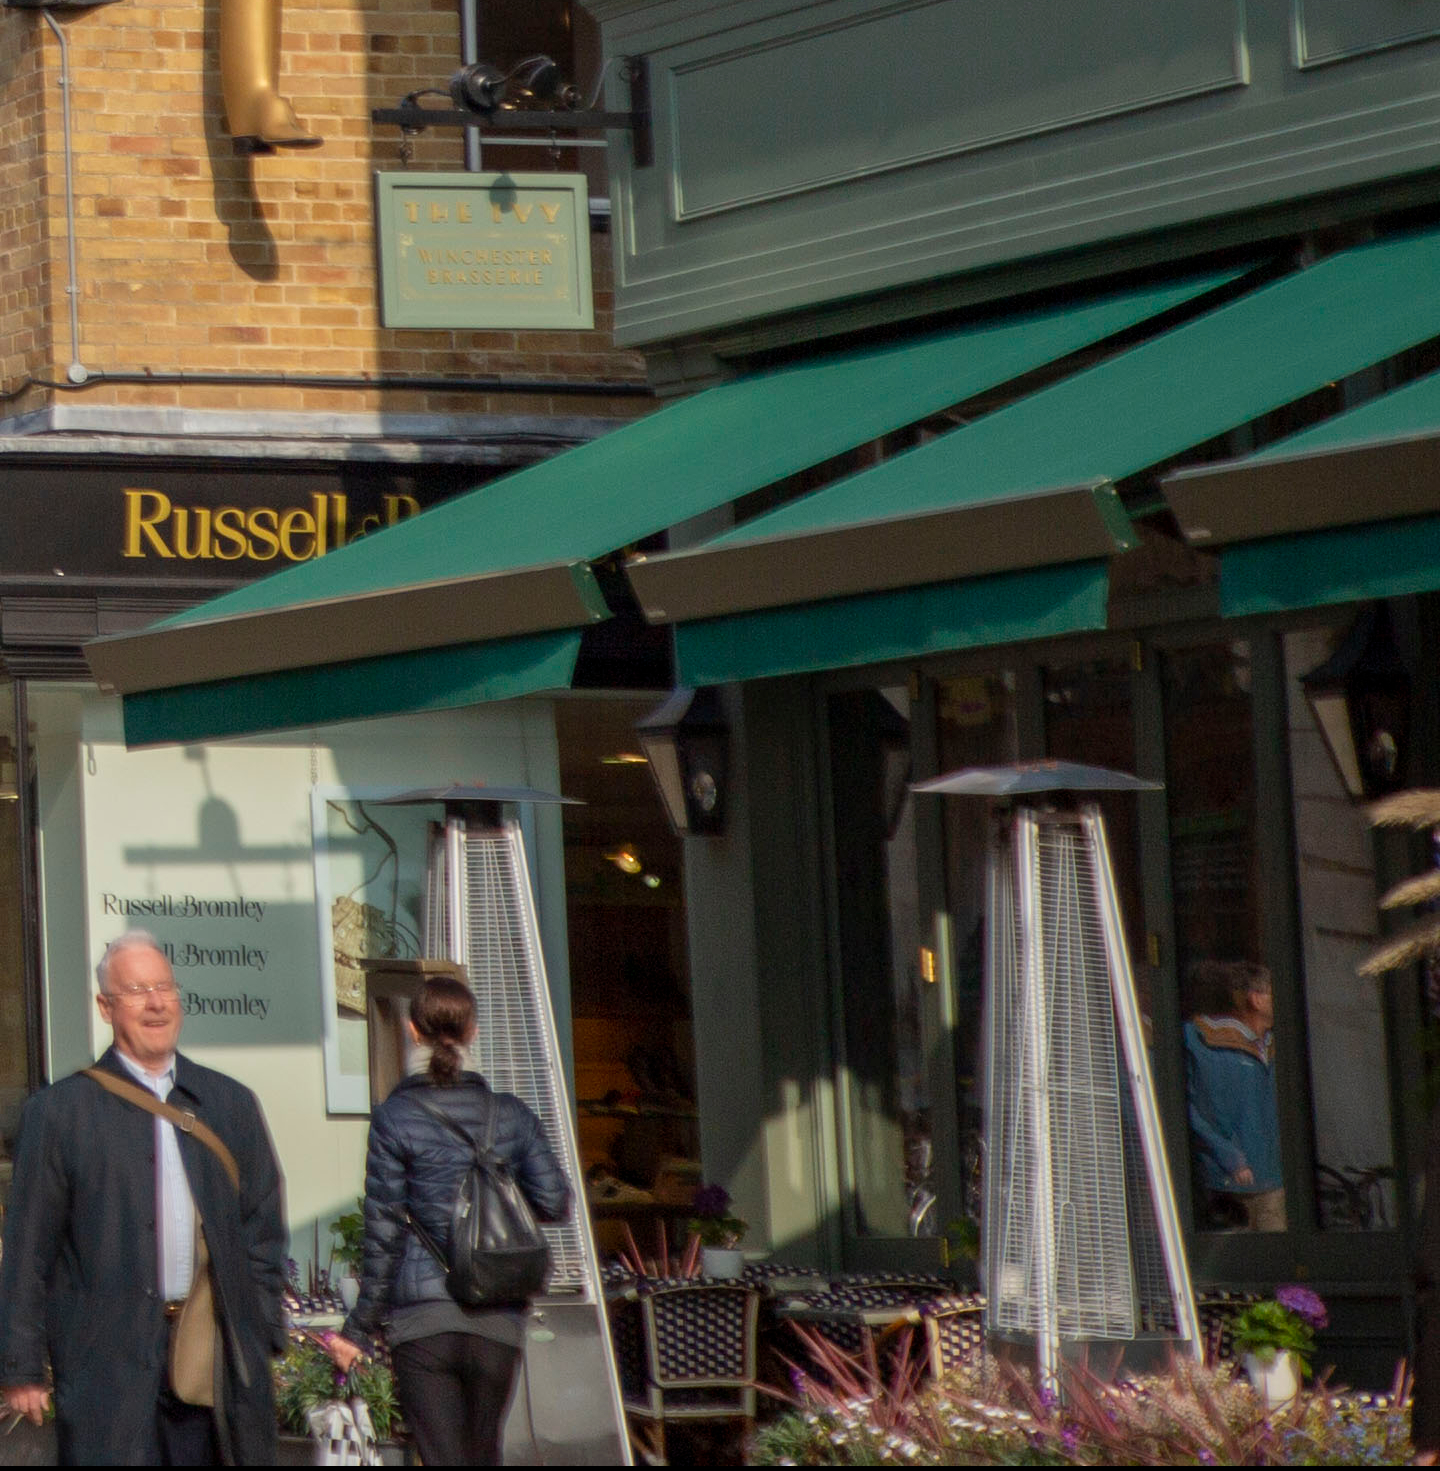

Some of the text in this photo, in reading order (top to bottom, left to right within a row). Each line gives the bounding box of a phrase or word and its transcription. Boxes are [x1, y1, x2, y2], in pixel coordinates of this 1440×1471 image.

[404, 201, 561, 225] THE IVY
[417, 249, 554, 266] WINCHESTER
[427, 269, 545, 286] BRASSERIE
